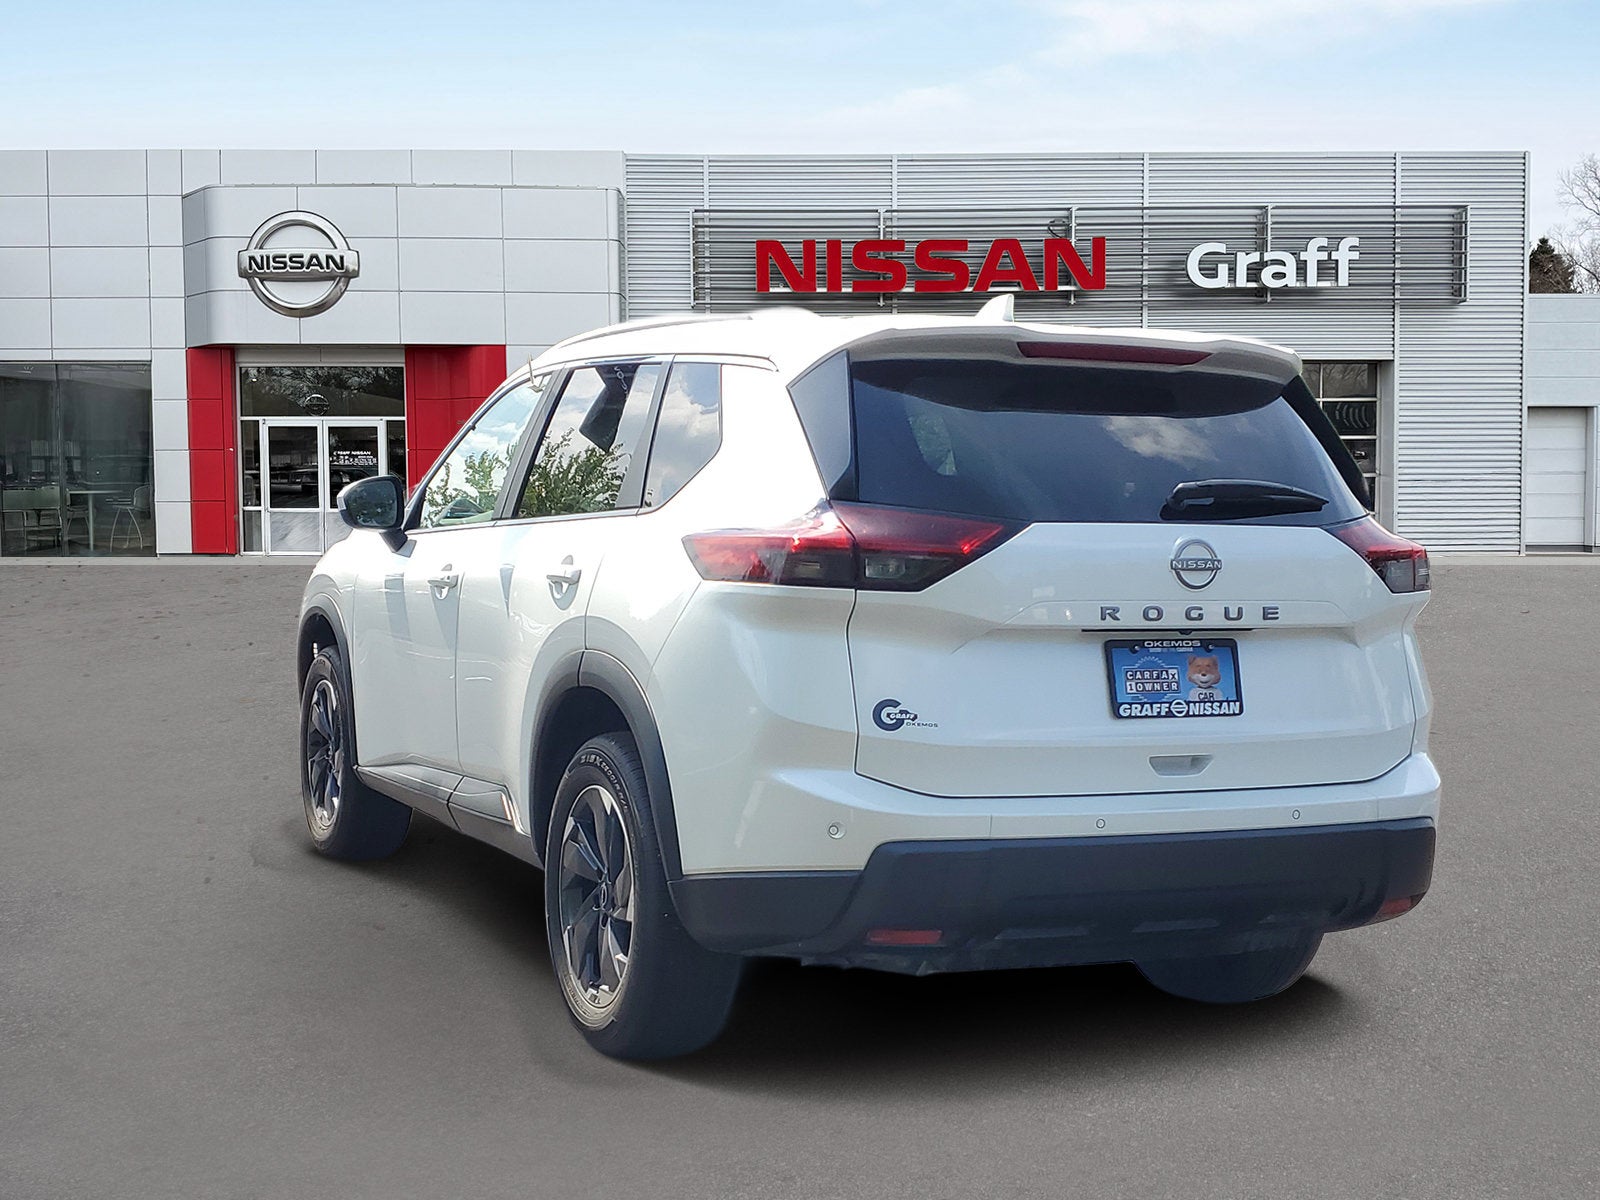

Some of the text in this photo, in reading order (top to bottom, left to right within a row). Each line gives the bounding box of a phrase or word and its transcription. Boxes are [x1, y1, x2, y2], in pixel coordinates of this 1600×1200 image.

[247, 253, 345, 272] NISSAN
[755, 236, 1107, 293] NISSAN
[1186, 236, 1360, 289] Graff
[1172, 559, 1222, 569] NISSAN
[1100, 605, 1279, 622] ROGUE
[1144, 640, 1201, 648] OKEMOS
[1126, 670, 1179, 681] CARFAX
[1198, 692, 1215, 701] CAR
[1119, 701, 1240, 717] GRAFF NISSAN
